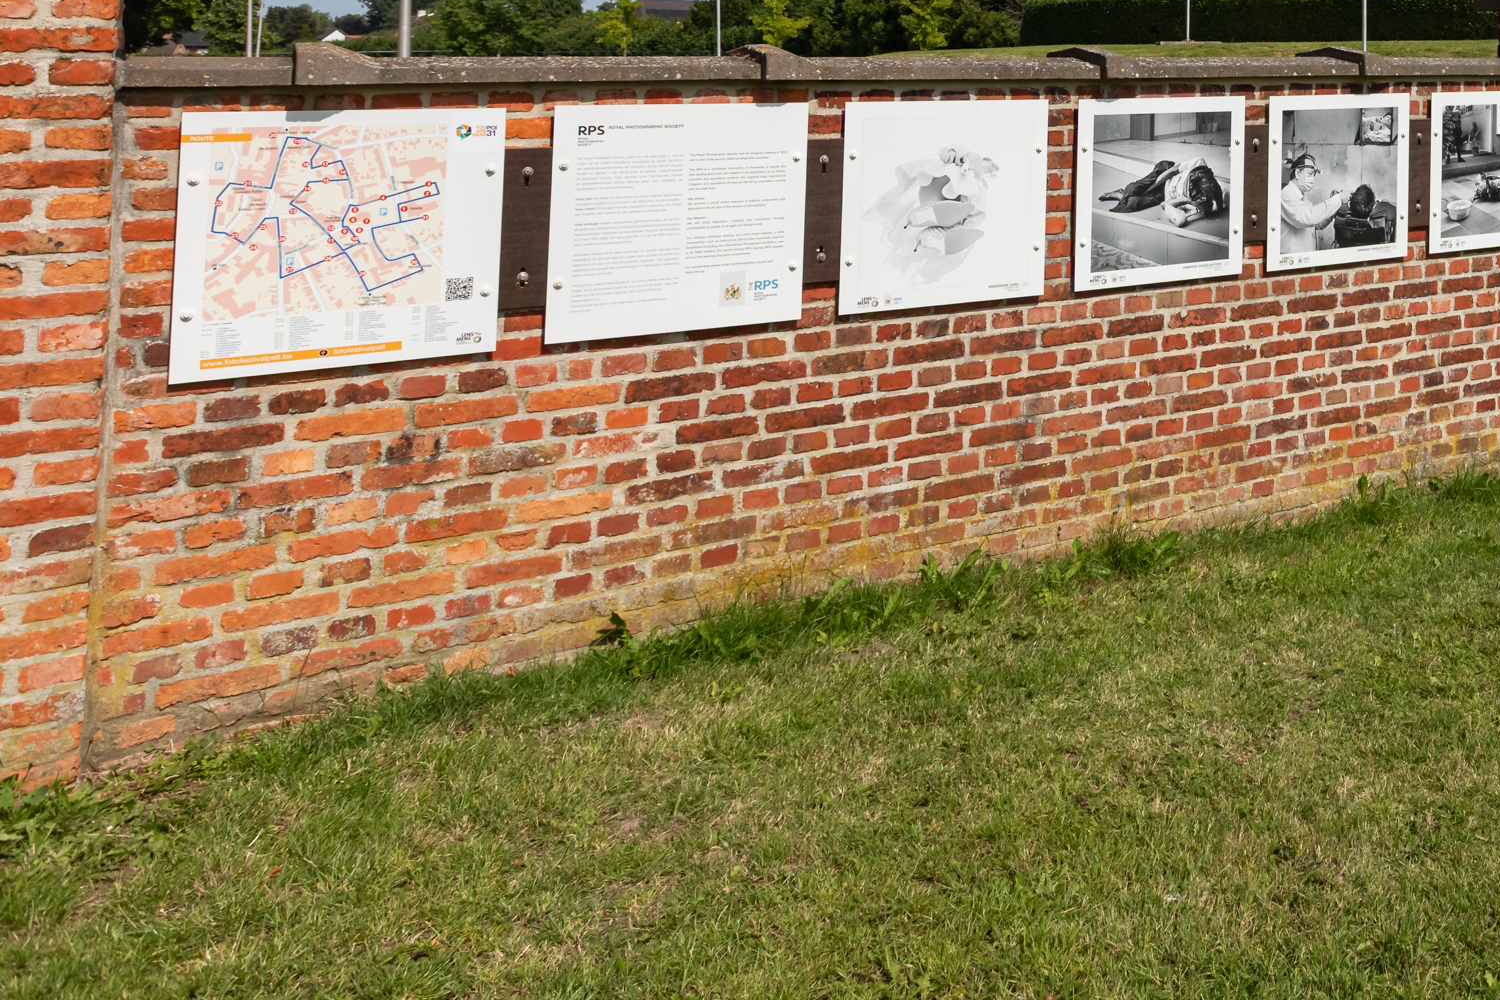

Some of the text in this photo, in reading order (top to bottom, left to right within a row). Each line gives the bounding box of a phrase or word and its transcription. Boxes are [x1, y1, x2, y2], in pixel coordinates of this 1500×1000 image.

[578, 125, 605, 136] RPS
[754, 279, 778, 290] RPS
[333, 344, 386, 355] fotofestivalpelt
[202, 353, 293, 368] www.fotofestivalpelt.be
